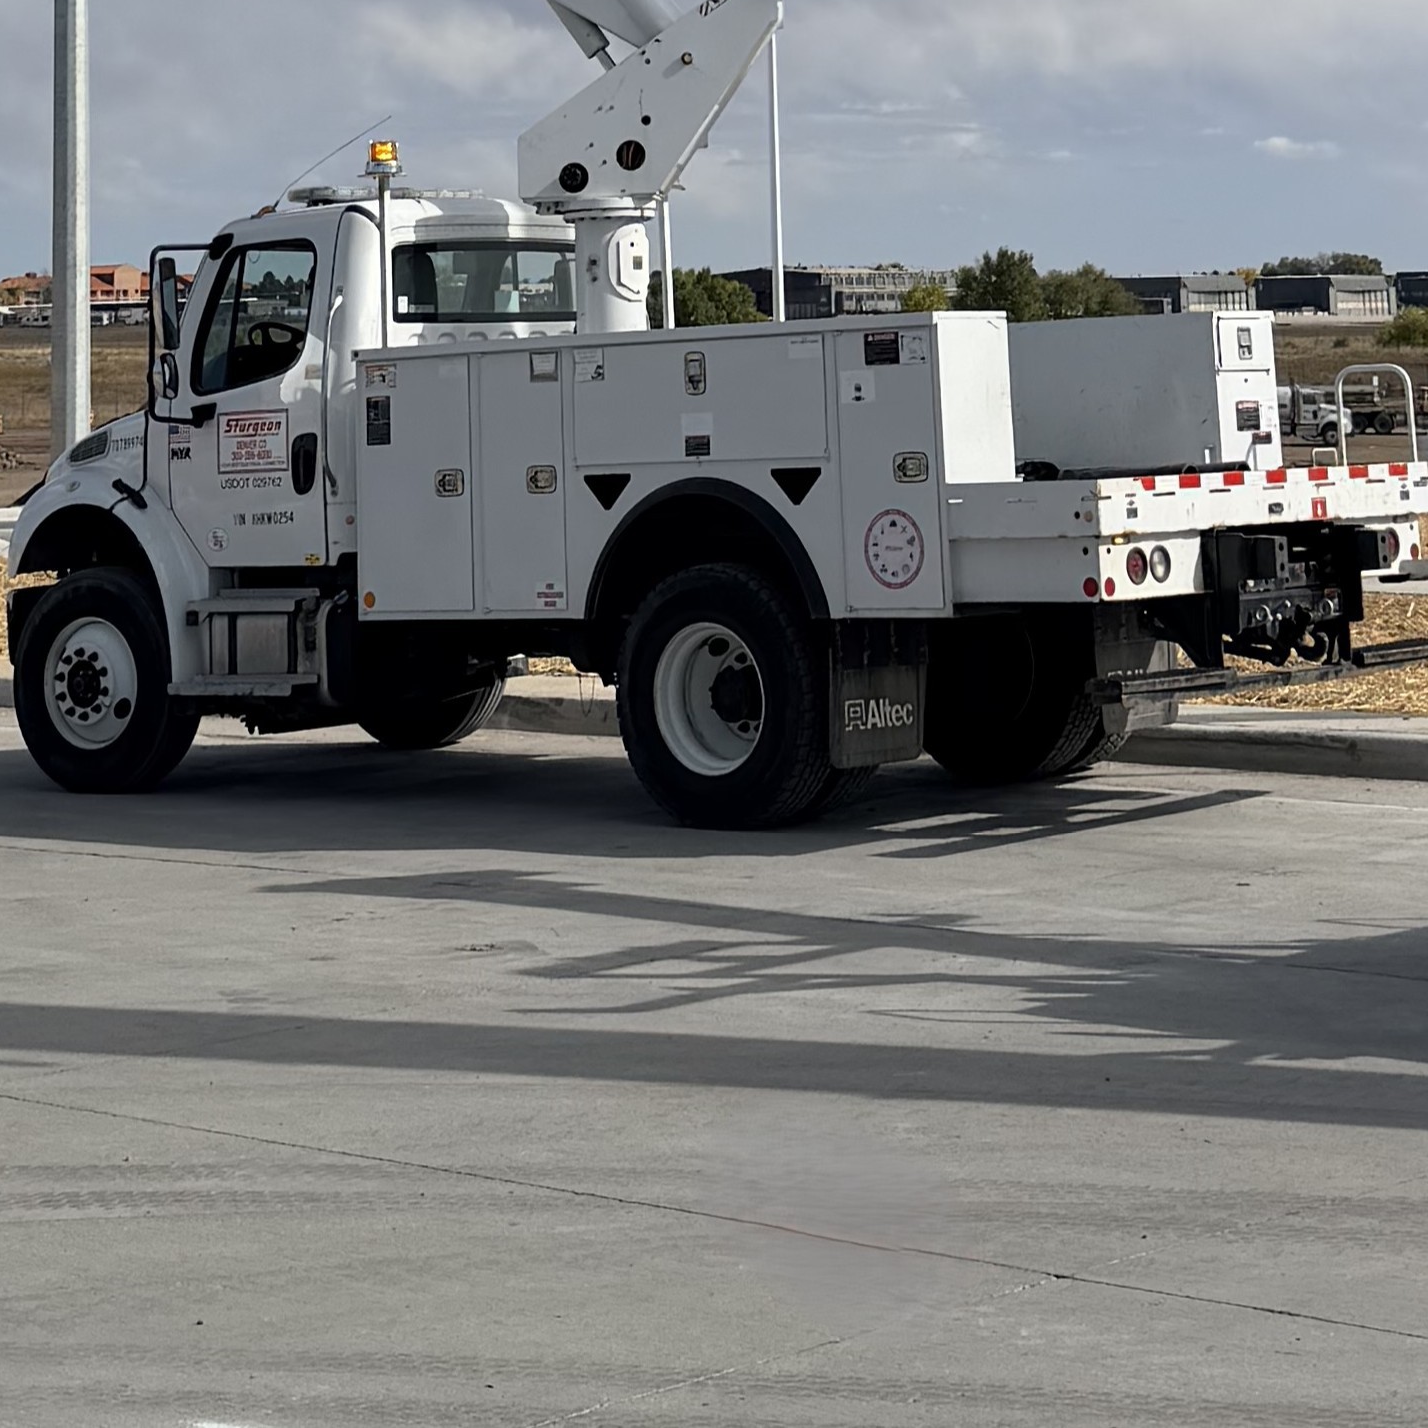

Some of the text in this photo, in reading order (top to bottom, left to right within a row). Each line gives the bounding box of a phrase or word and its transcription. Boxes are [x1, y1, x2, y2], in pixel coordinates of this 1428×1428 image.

[223, 418, 282, 436] Sturgeon
[220, 477, 250, 490] USDOT
[867, 697, 913, 729] Altec
